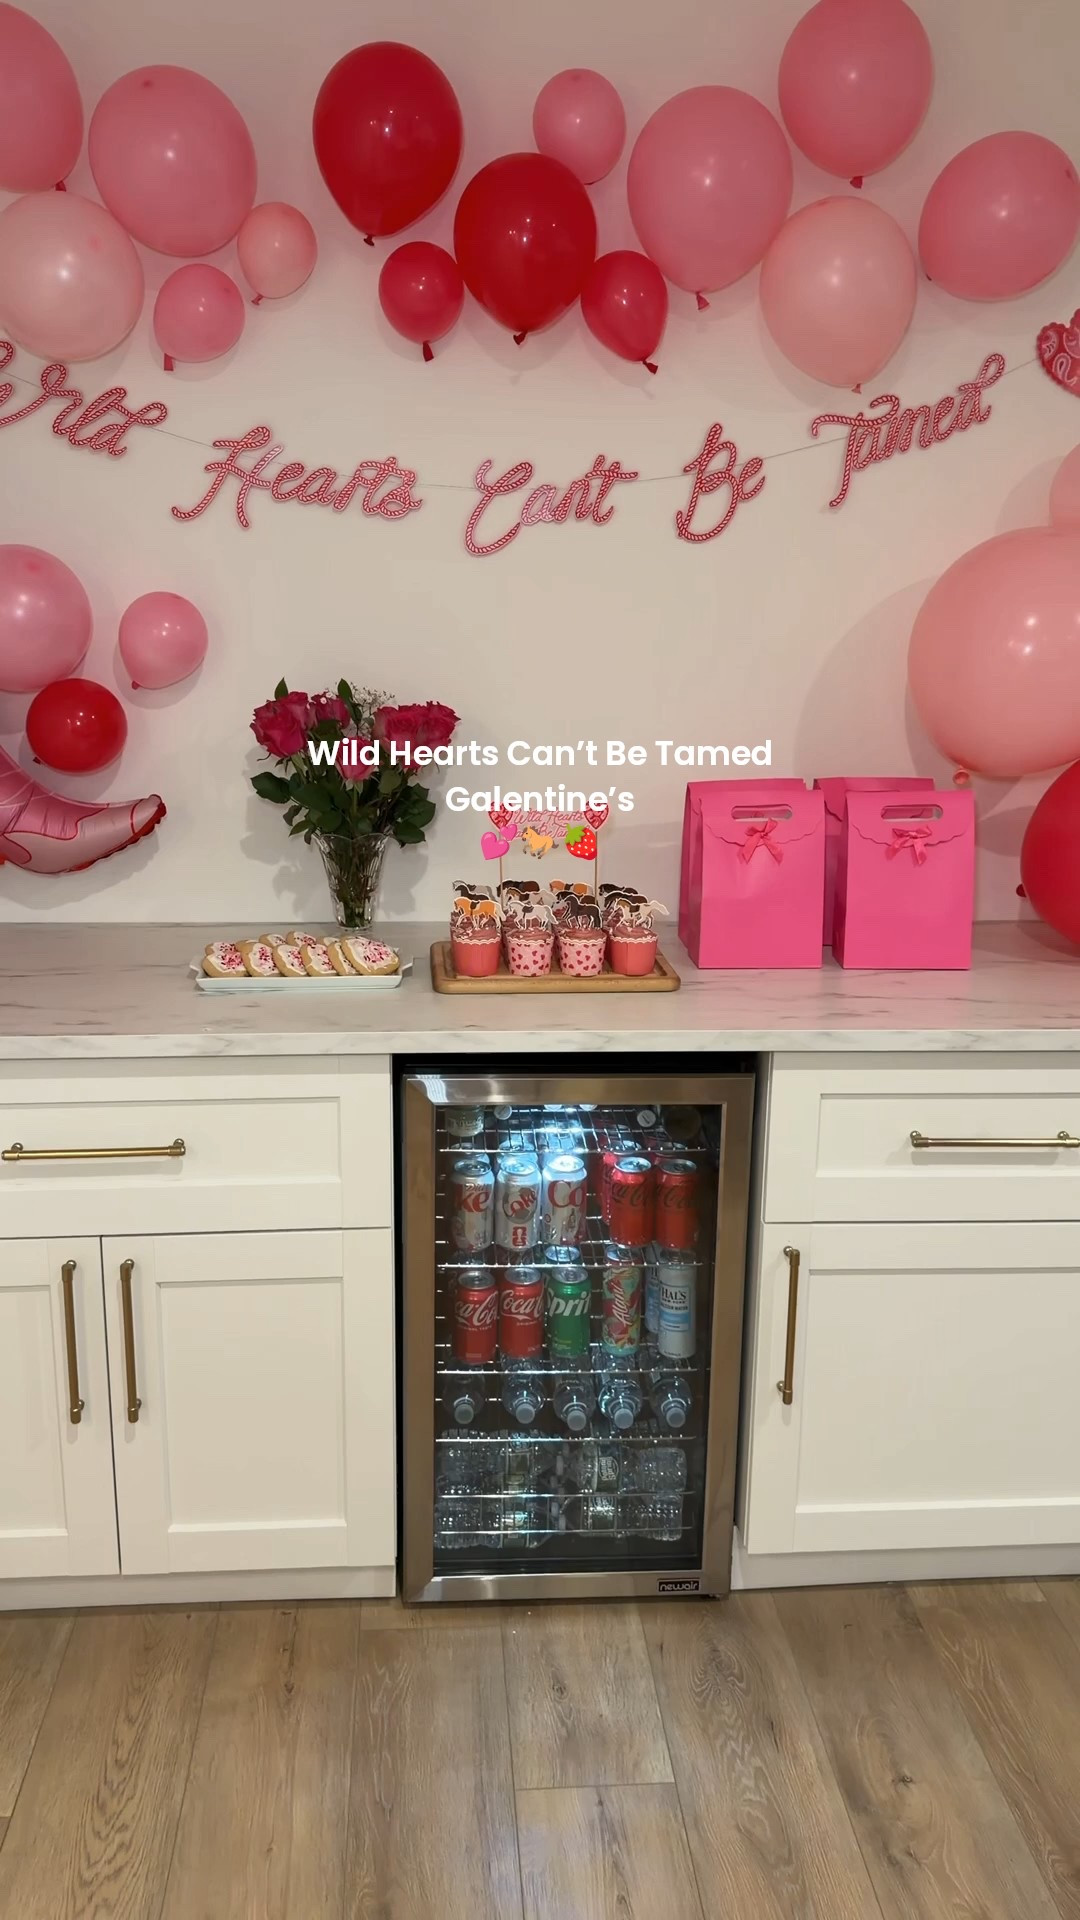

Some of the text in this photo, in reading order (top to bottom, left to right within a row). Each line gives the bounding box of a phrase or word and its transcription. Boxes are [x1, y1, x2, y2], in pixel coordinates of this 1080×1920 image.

[171, 426, 423, 528] Hearts
[676, 422, 765, 543] Be
[811, 353, 1005, 508] Tamed
[660, 1581, 698, 1591] newair
